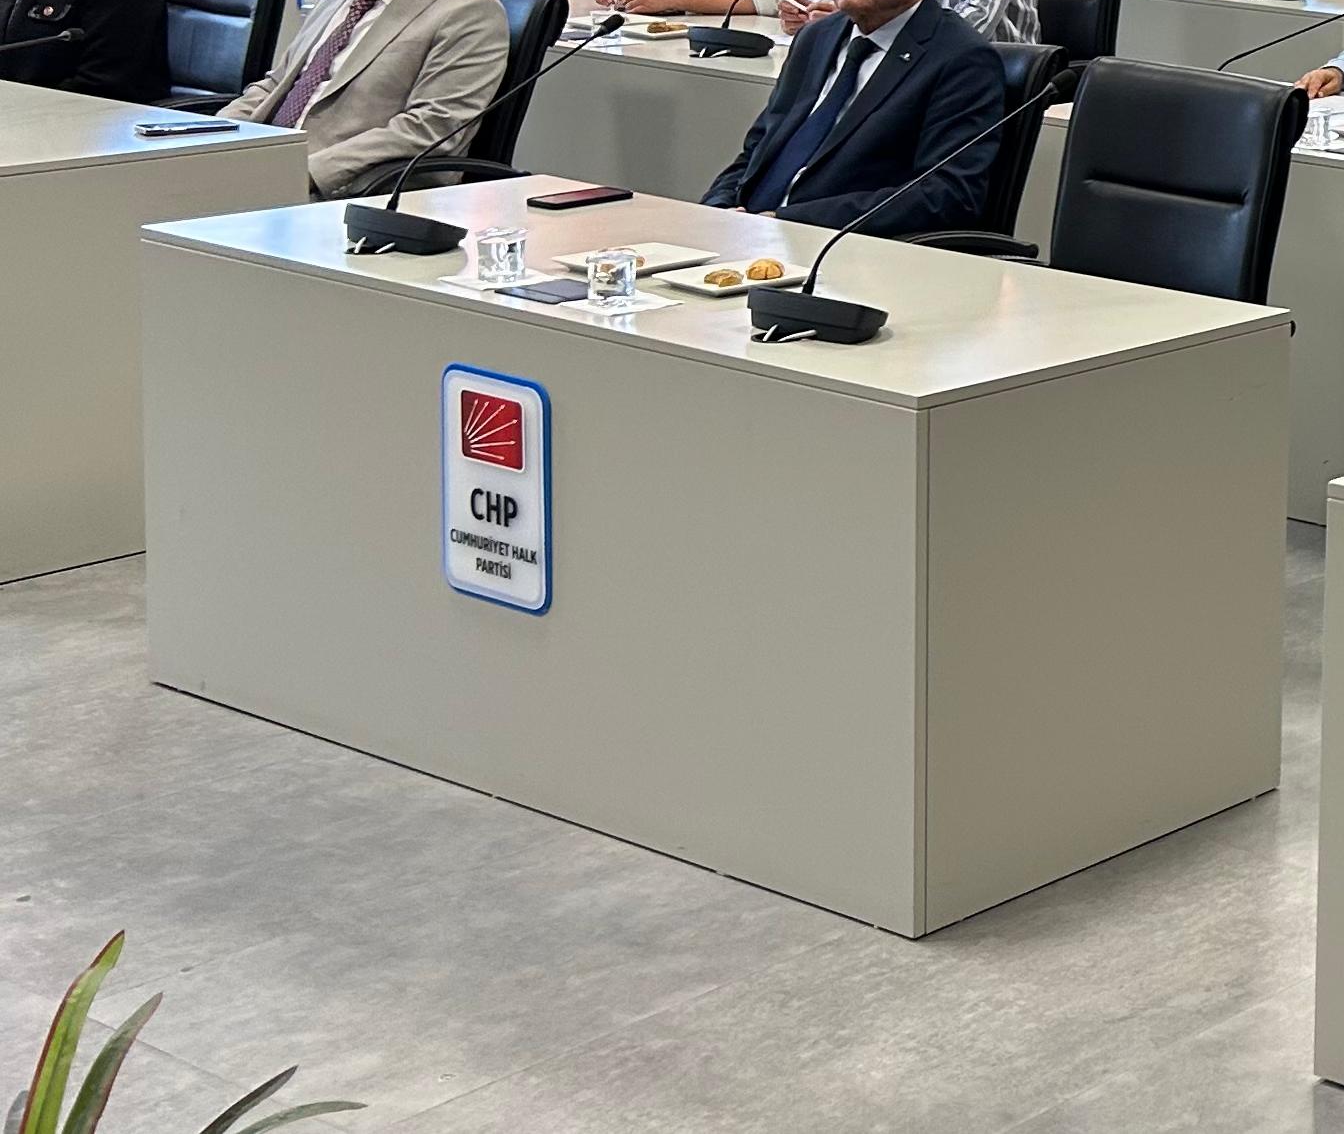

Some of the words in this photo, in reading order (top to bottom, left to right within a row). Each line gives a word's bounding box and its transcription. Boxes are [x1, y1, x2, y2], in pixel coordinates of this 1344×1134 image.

[470, 488, 518, 528] CHP
[450, 528, 510, 556] CUMHURİYET
[511, 545, 538, 565] HALK
[476, 557, 512, 579] PARTİSİ
